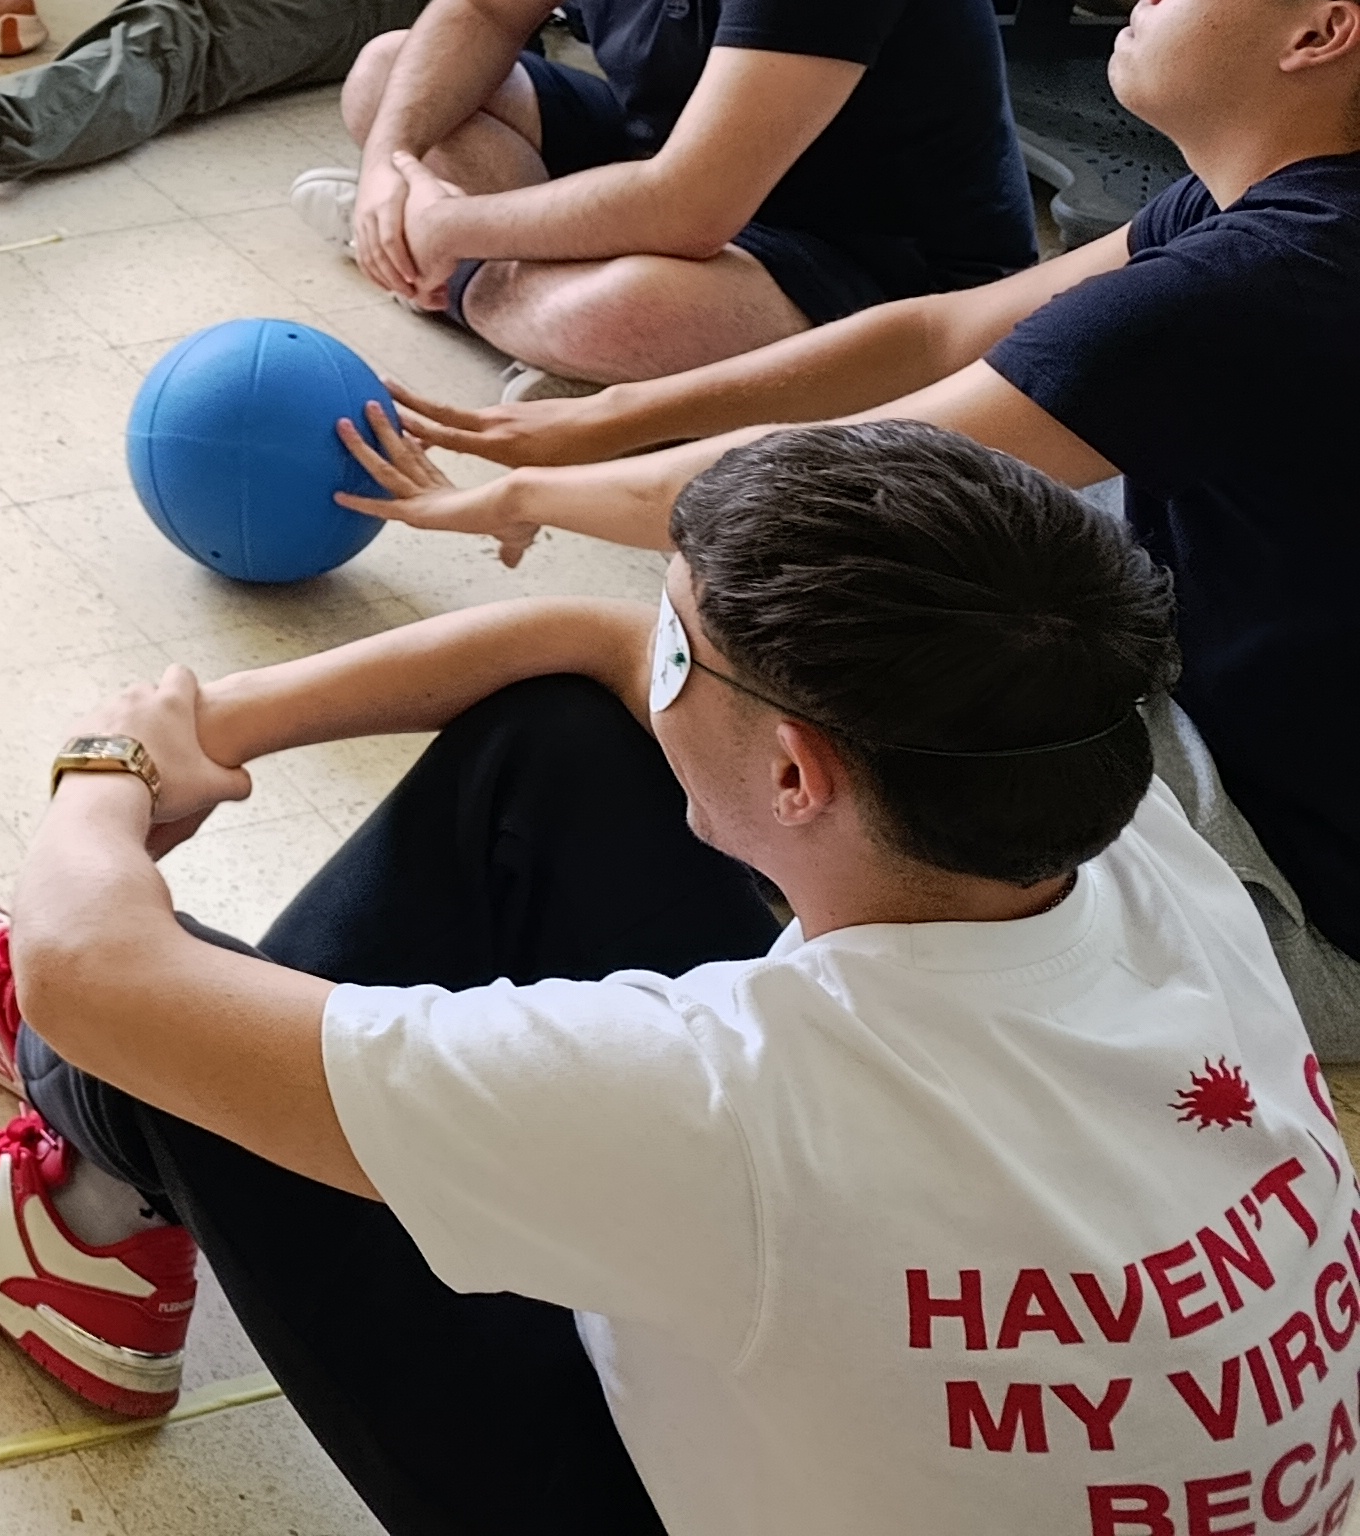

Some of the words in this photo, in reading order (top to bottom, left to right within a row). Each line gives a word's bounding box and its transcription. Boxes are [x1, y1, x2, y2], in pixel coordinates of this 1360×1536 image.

[904, 1156, 1319, 1353] HAVEN'T
[945, 1378, 1133, 1454] MY
[1167, 1206, 1360, 1442] VIRGI
[1086, 1368, 1360, 1536] BECA
